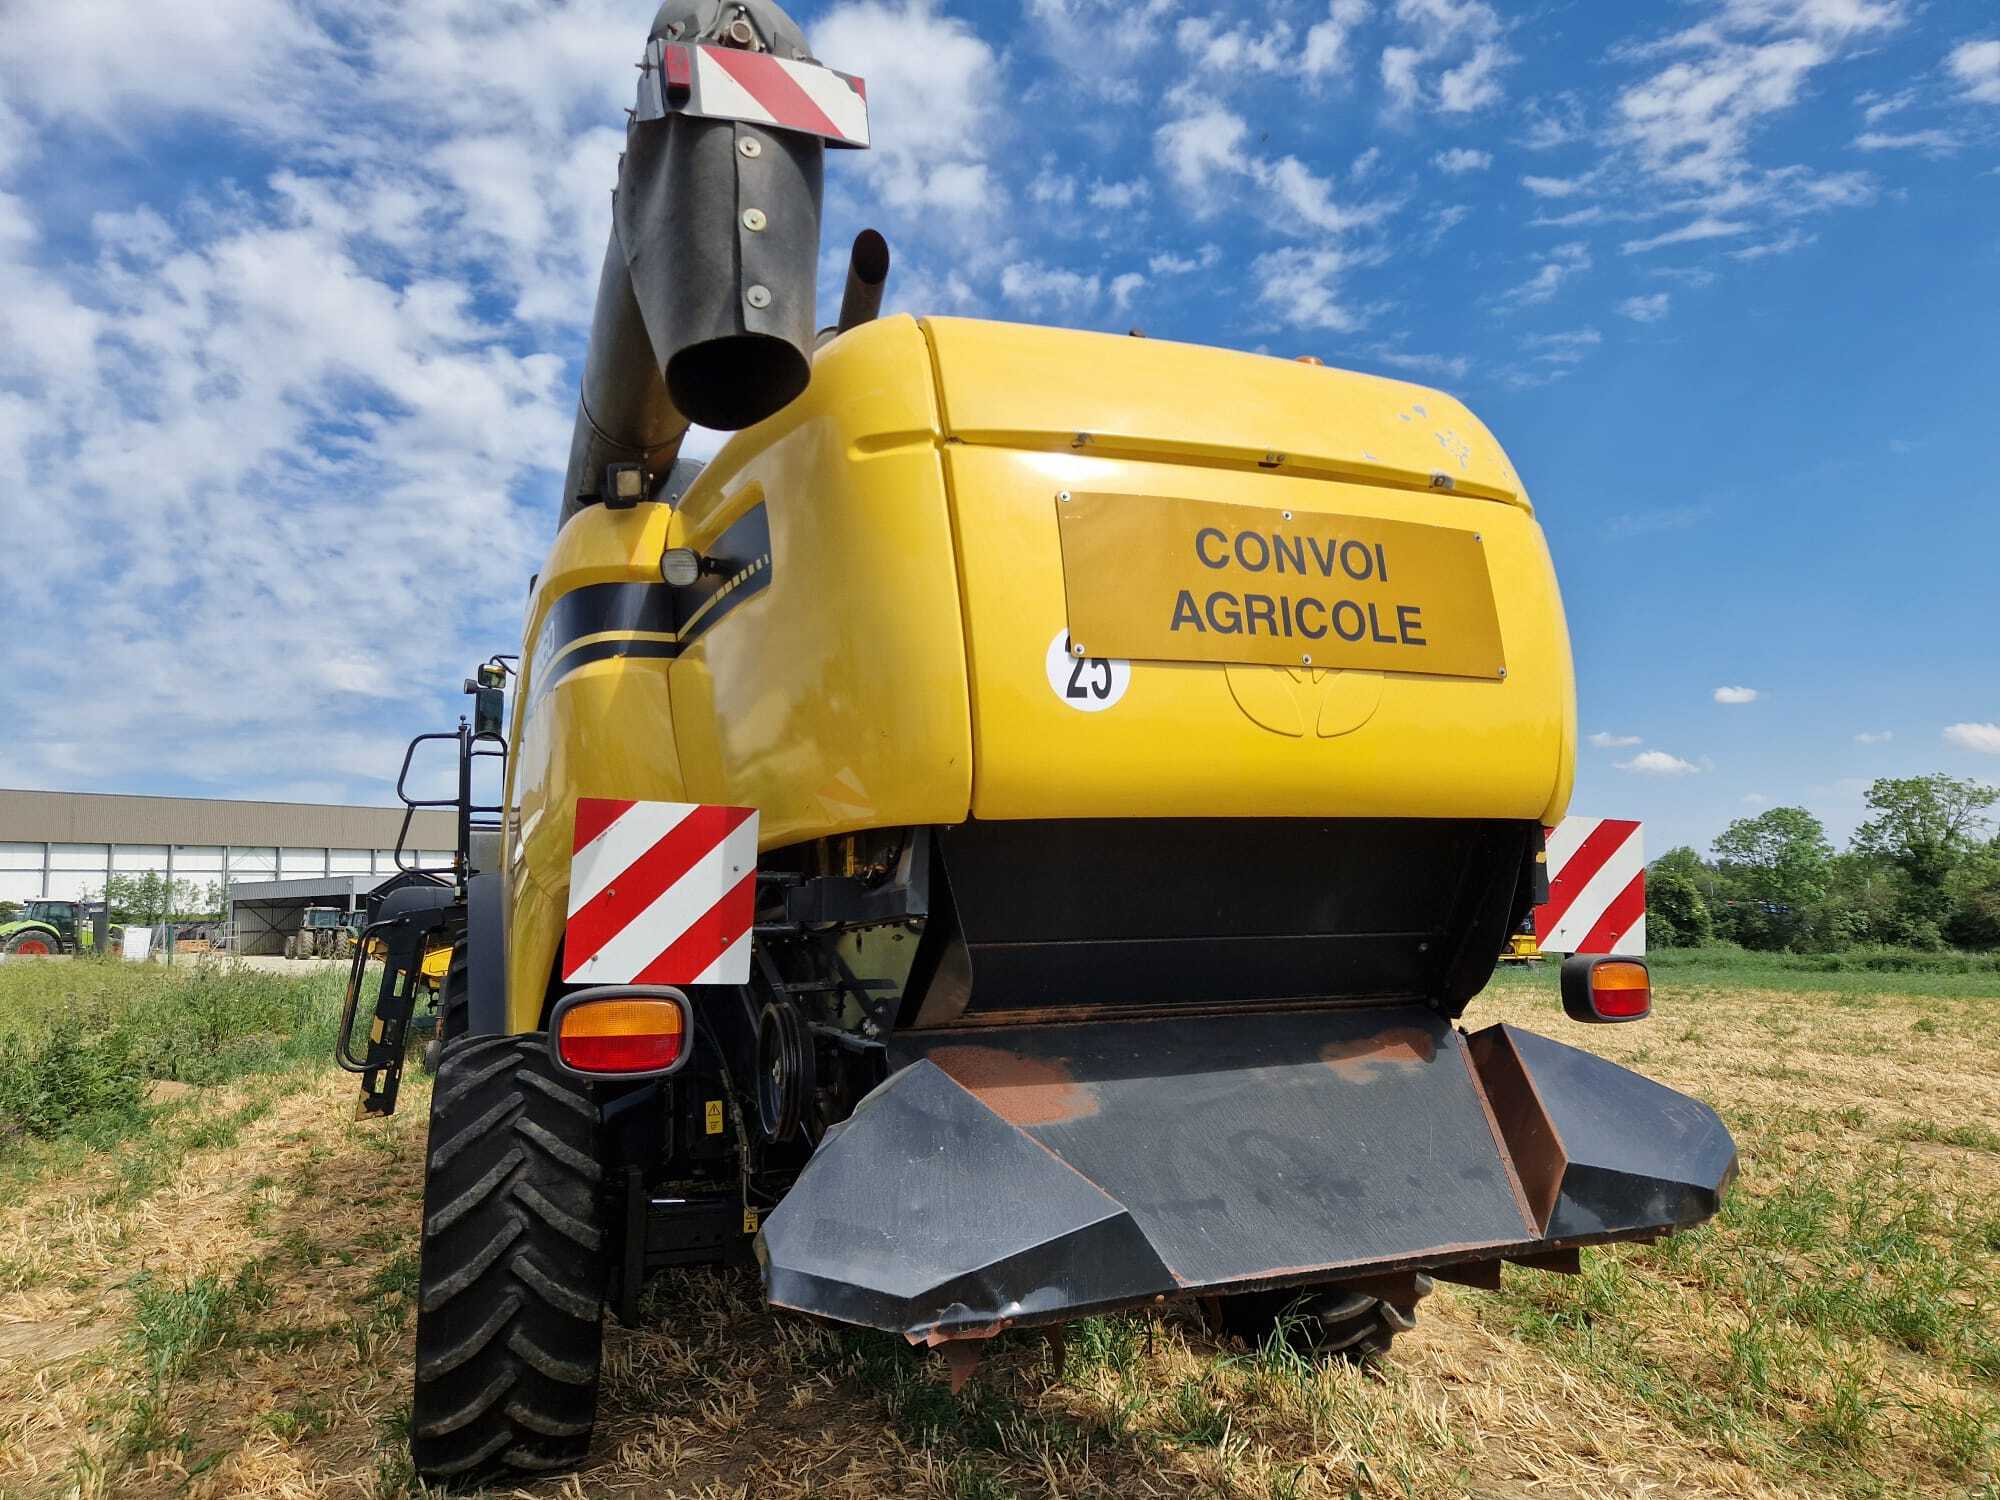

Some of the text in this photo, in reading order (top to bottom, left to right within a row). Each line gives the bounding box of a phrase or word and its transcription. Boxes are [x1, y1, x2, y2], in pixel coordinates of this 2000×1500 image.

[1195, 527, 1388, 582] CONVOI
[1170, 590, 1427, 646] AGRICOLE
[1065, 634, 1112, 699] 25
